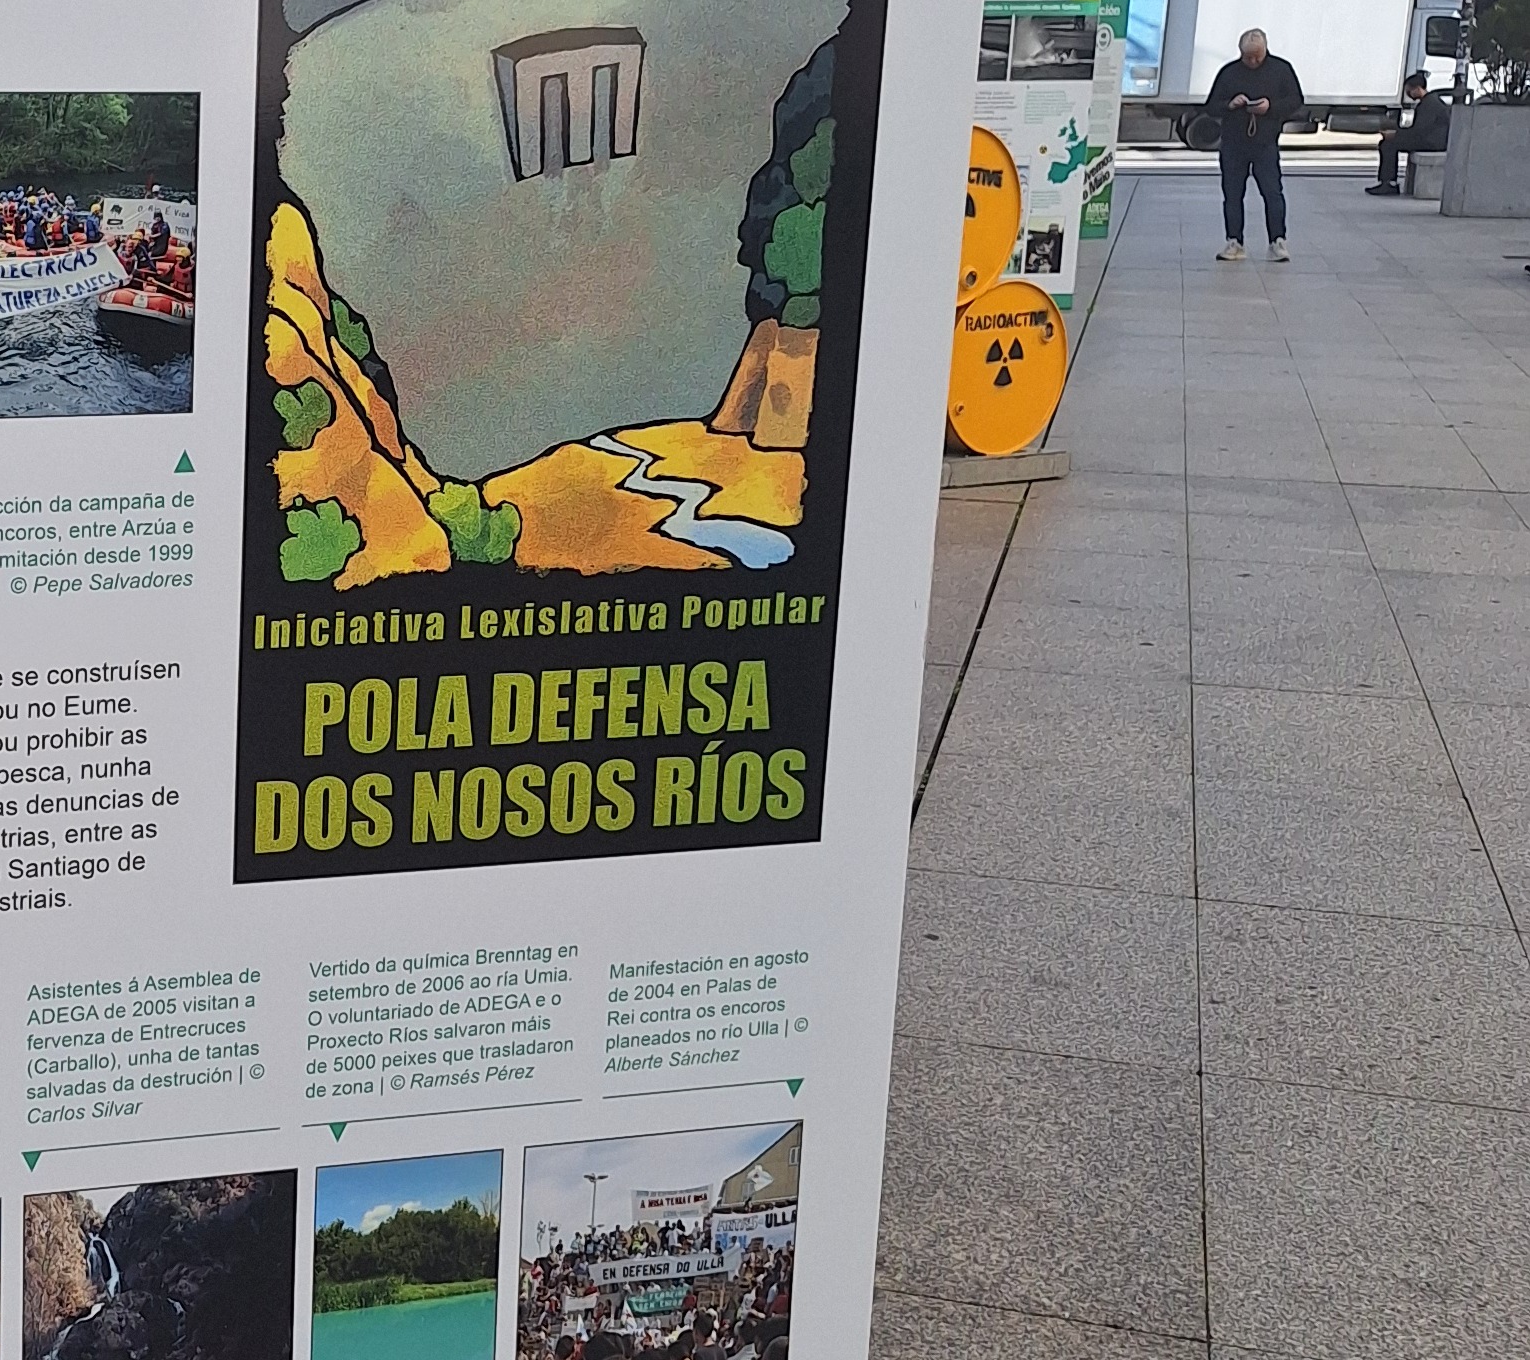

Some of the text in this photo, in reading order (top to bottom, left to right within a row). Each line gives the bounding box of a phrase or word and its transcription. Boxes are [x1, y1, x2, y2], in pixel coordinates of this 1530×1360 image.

[49, 495, 72, 513] da
[78, 492, 165, 515] campaña
[171, 490, 195, 508] de
[254, 592, 825, 650] Iniciativa Lexislativa Popular
[11, 670, 39, 687] se
[46, 659, 180, 685] construísen
[303, 660, 770, 756] POLA DEFENSA
[254, 740, 806, 854] DOS NOSOS RÍOS
[308, 944, 578, 978] Vertido da química Brenntag en
[609, 949, 809, 980] Manifestación en agosto
[26, 967, 261, 1002] Asistentes á Asemblea de
[602, 1256, 724, 1280] EN DEFENSA DO ULLA
